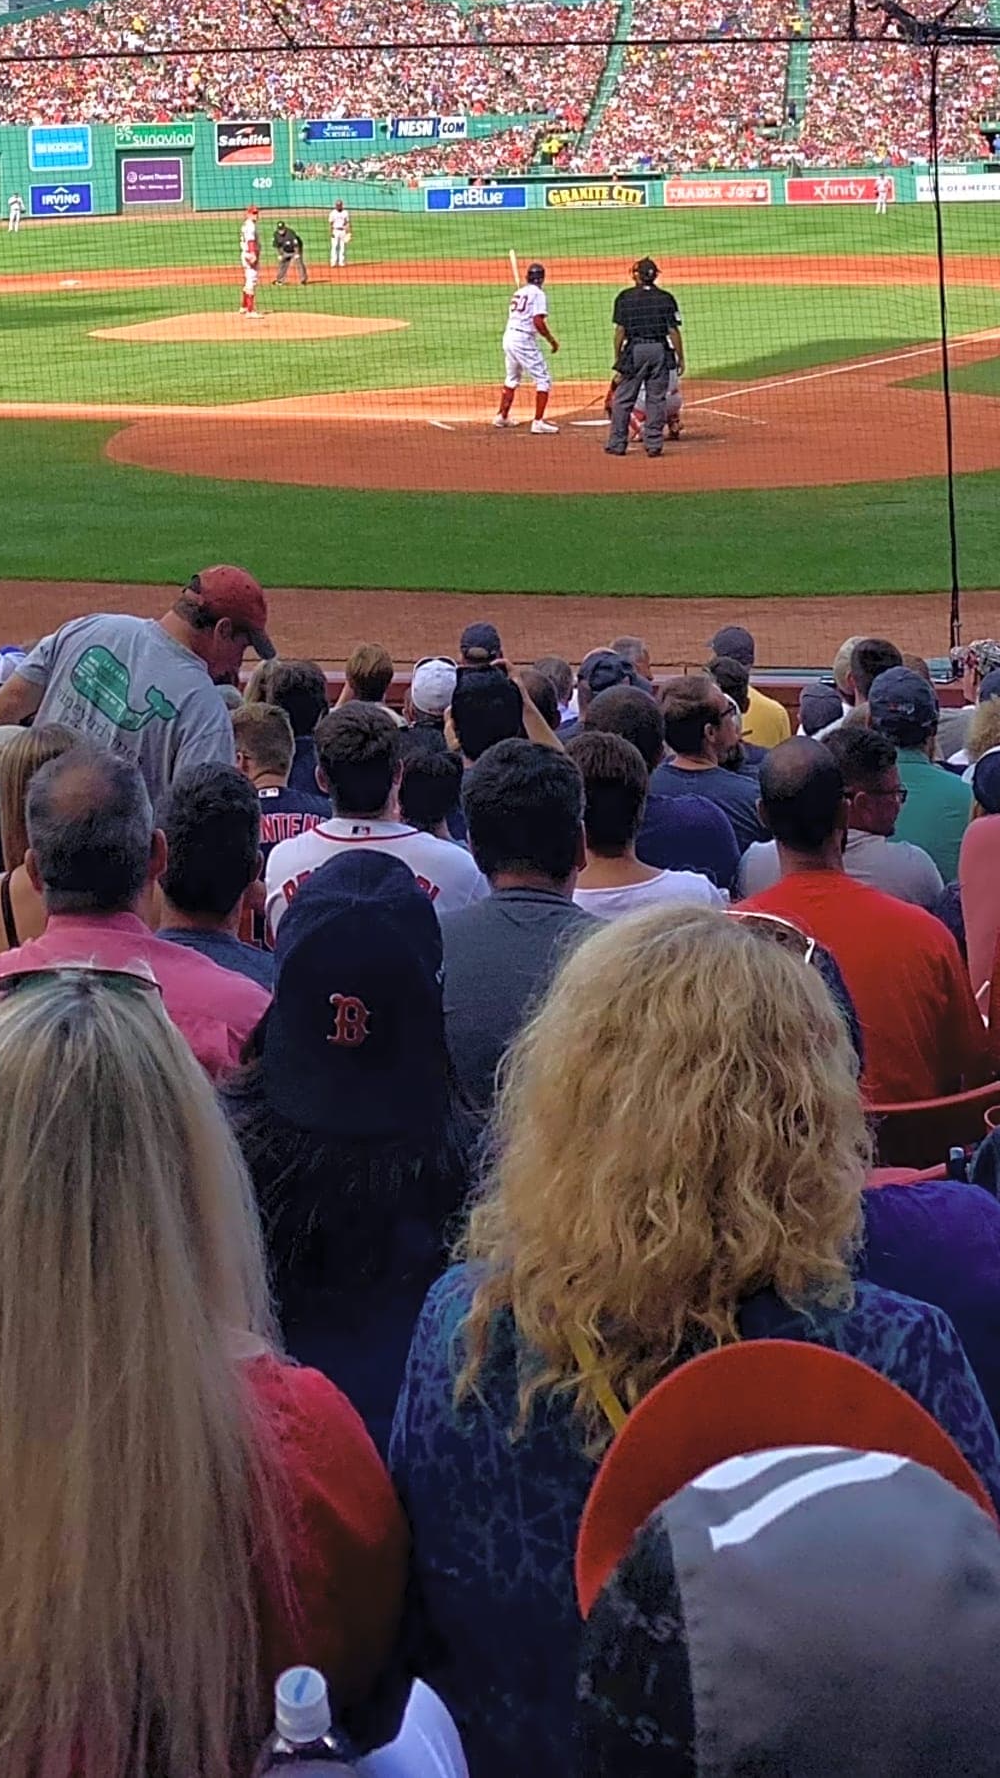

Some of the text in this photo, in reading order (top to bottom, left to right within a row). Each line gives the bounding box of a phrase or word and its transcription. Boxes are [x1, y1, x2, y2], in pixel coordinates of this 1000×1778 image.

[397, 120, 433, 136] NESN
[218, 132, 271, 147] Safelite
[253, 177, 273, 188] 420
[449, 189, 504, 209] jetBlue
[548, 186, 645, 205] GRANITE CITY
[668, 185, 768, 199] TRADER JOE'S
[814, 181, 866, 201] xfinity
[42, 194, 80, 205] IRVING
[327, 993, 372, 1046] B
